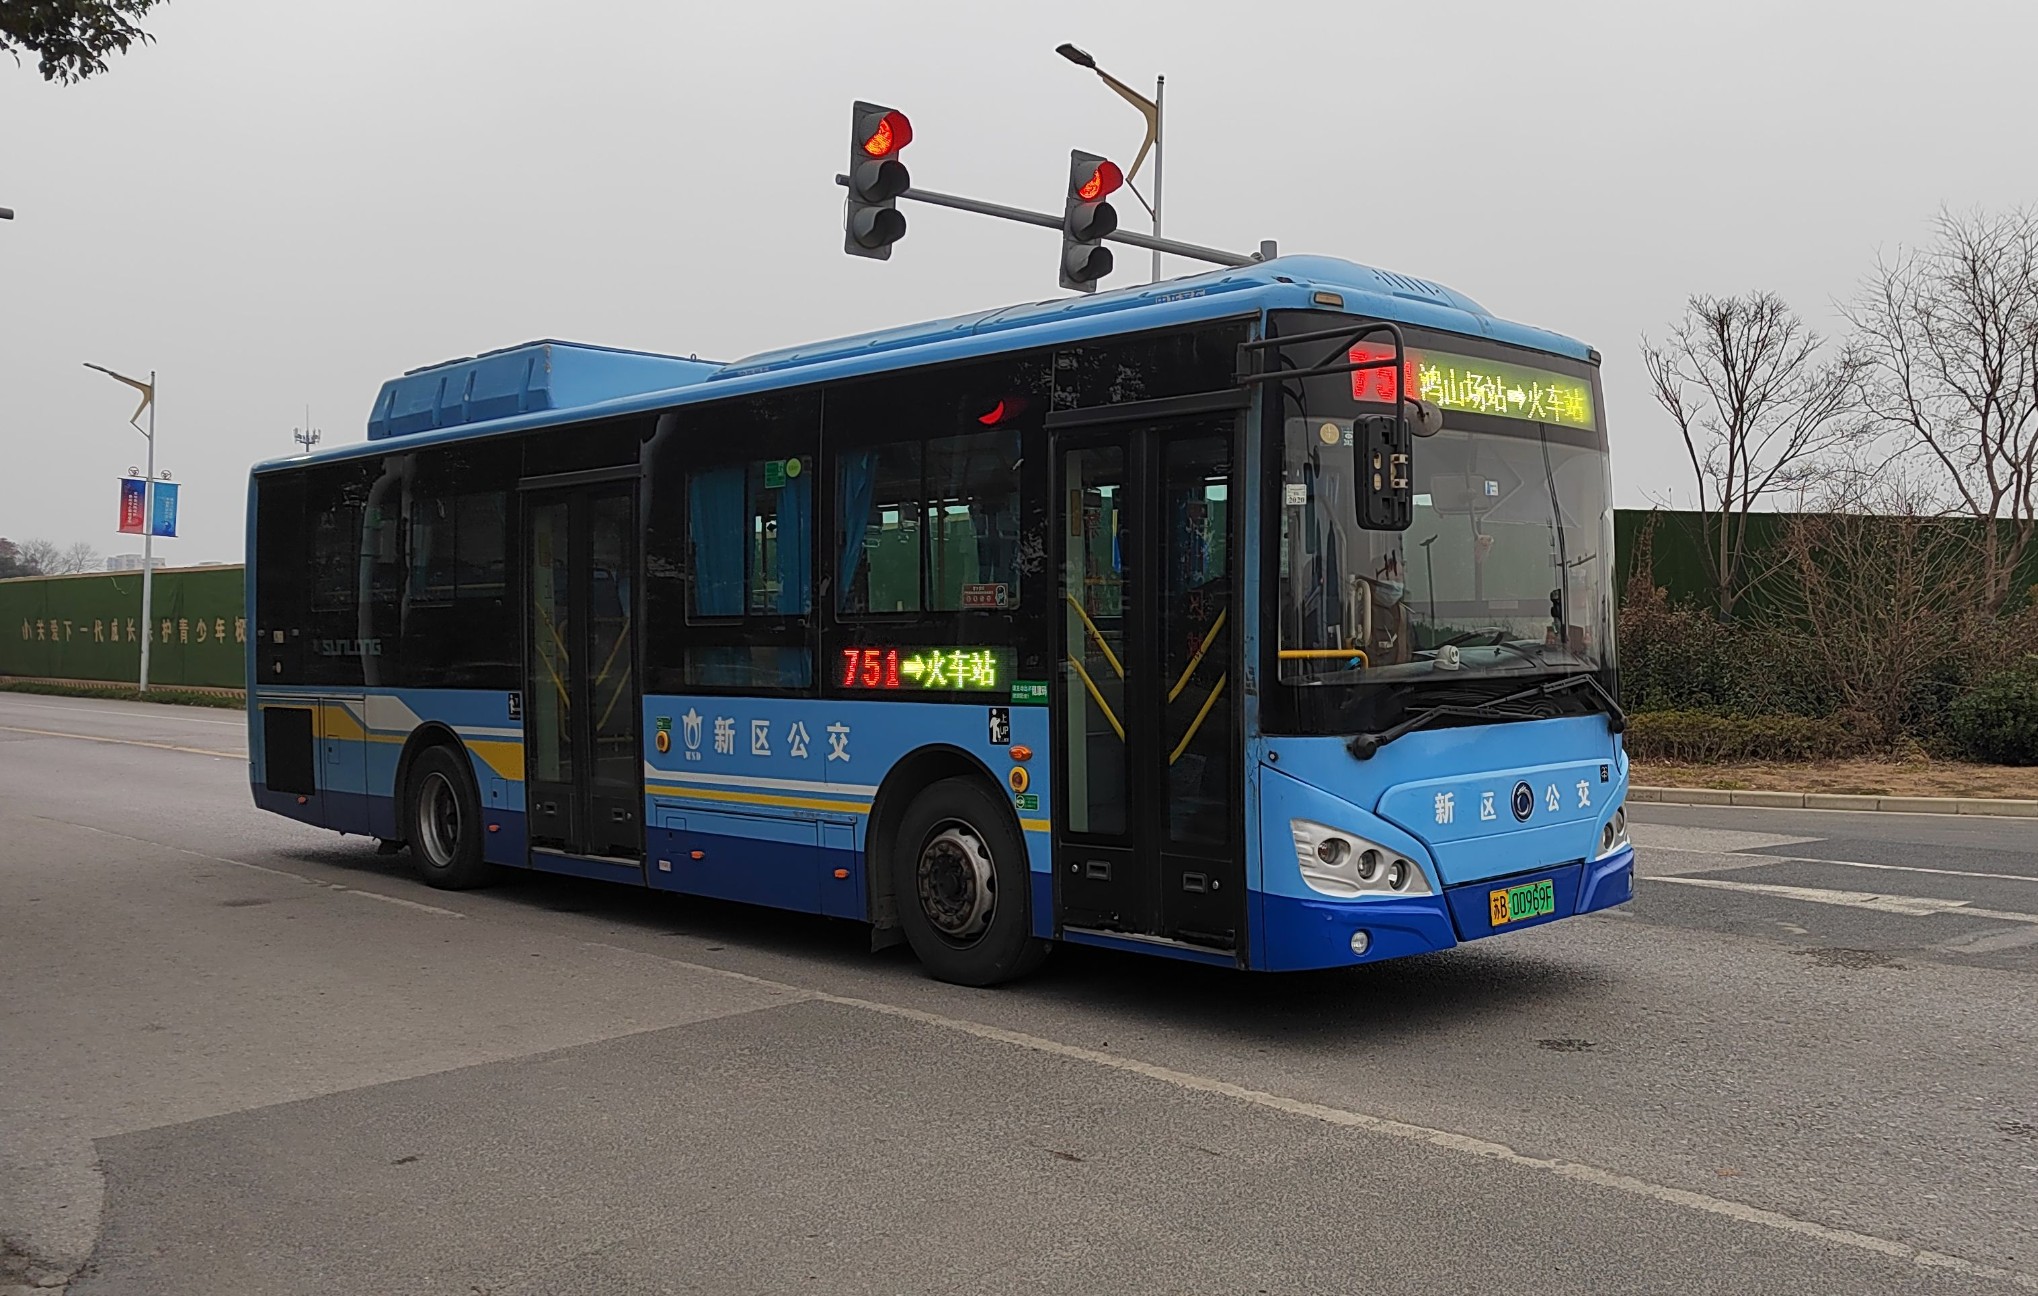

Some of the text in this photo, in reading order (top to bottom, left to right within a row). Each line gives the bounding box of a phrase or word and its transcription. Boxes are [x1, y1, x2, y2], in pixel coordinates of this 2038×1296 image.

[844, 649, 996, 688] 751 火车站
[714, 716, 851, 762] 新区公交
